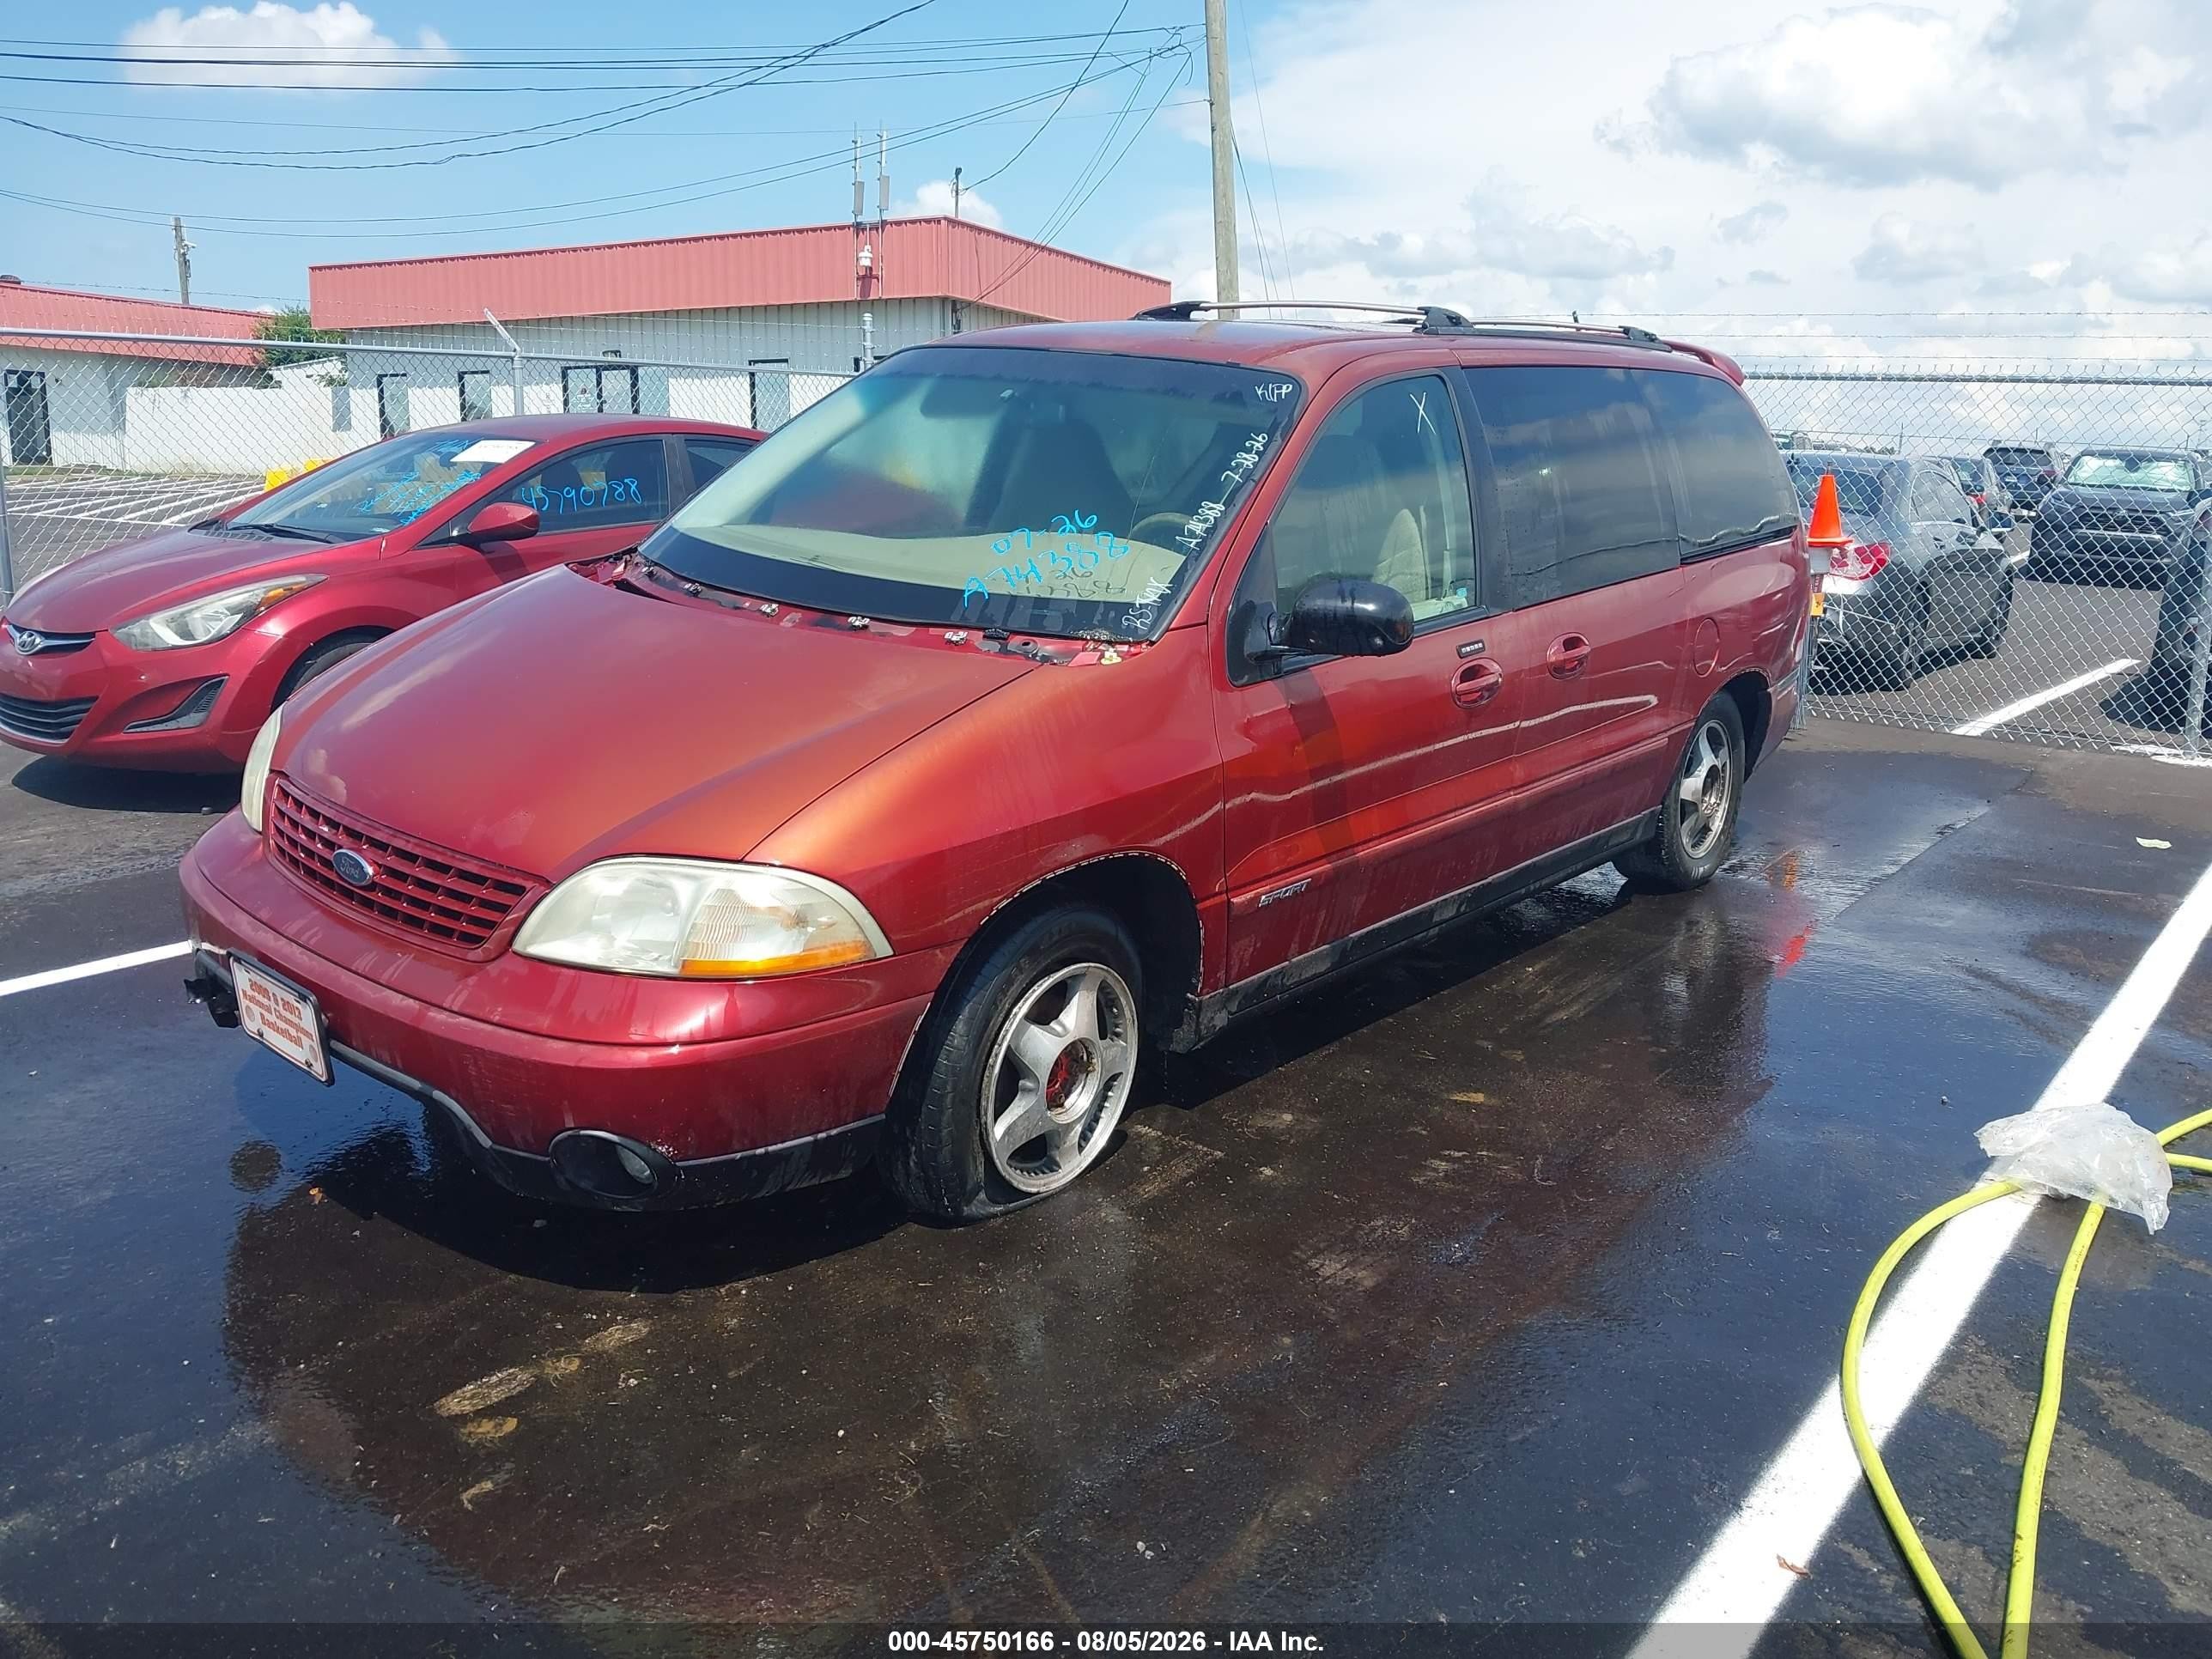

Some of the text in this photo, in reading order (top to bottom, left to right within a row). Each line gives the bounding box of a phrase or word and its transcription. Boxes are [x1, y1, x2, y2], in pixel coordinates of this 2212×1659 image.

[1258, 878, 1312, 908] SPORT
[241, 988, 315, 1042] National Champions
[259, 1012, 304, 1050] Basketball
